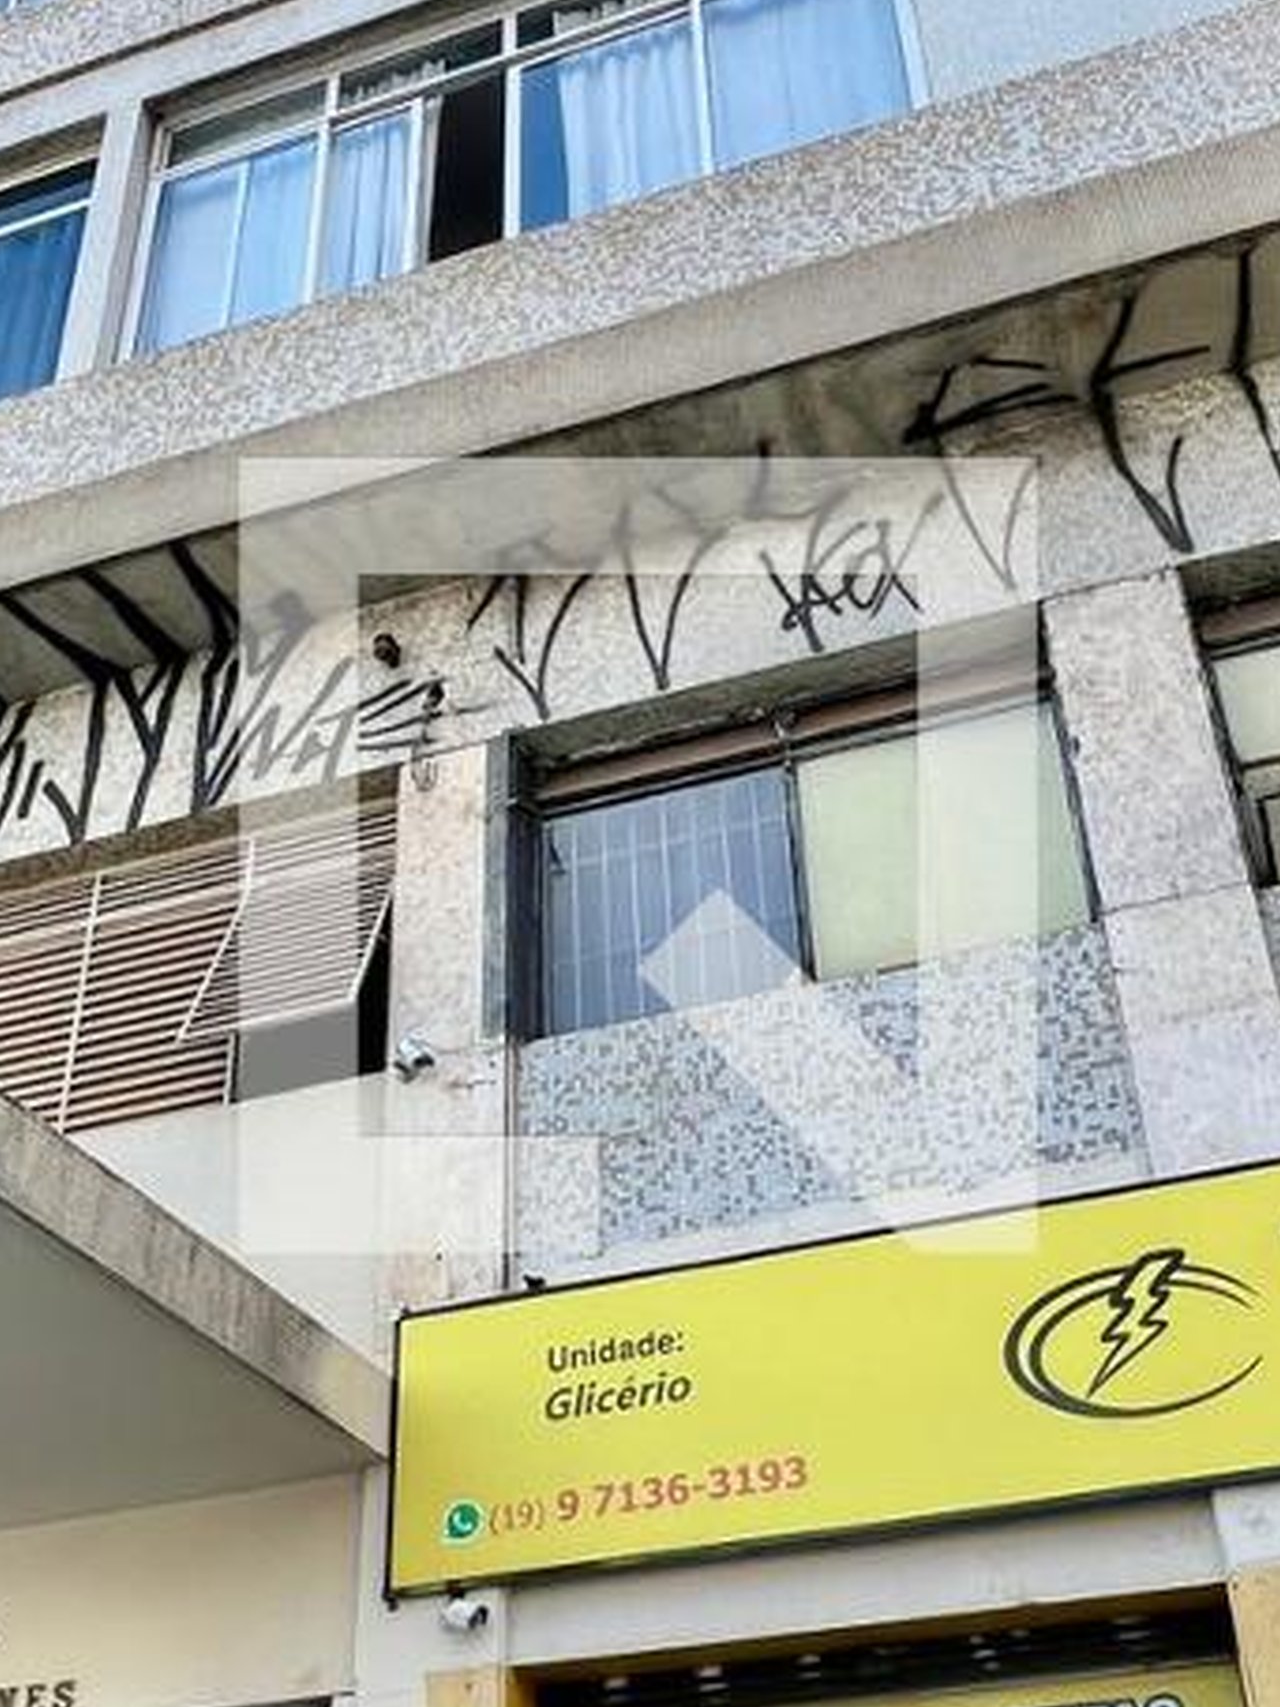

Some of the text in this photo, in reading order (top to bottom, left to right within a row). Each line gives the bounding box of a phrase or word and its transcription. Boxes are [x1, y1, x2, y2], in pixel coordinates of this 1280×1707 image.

[547, 1330, 685, 1373] Unidade:
[544, 1370, 692, 1421] Glicério
[489, 1455, 808, 1535] (19) 9 7136-3193
